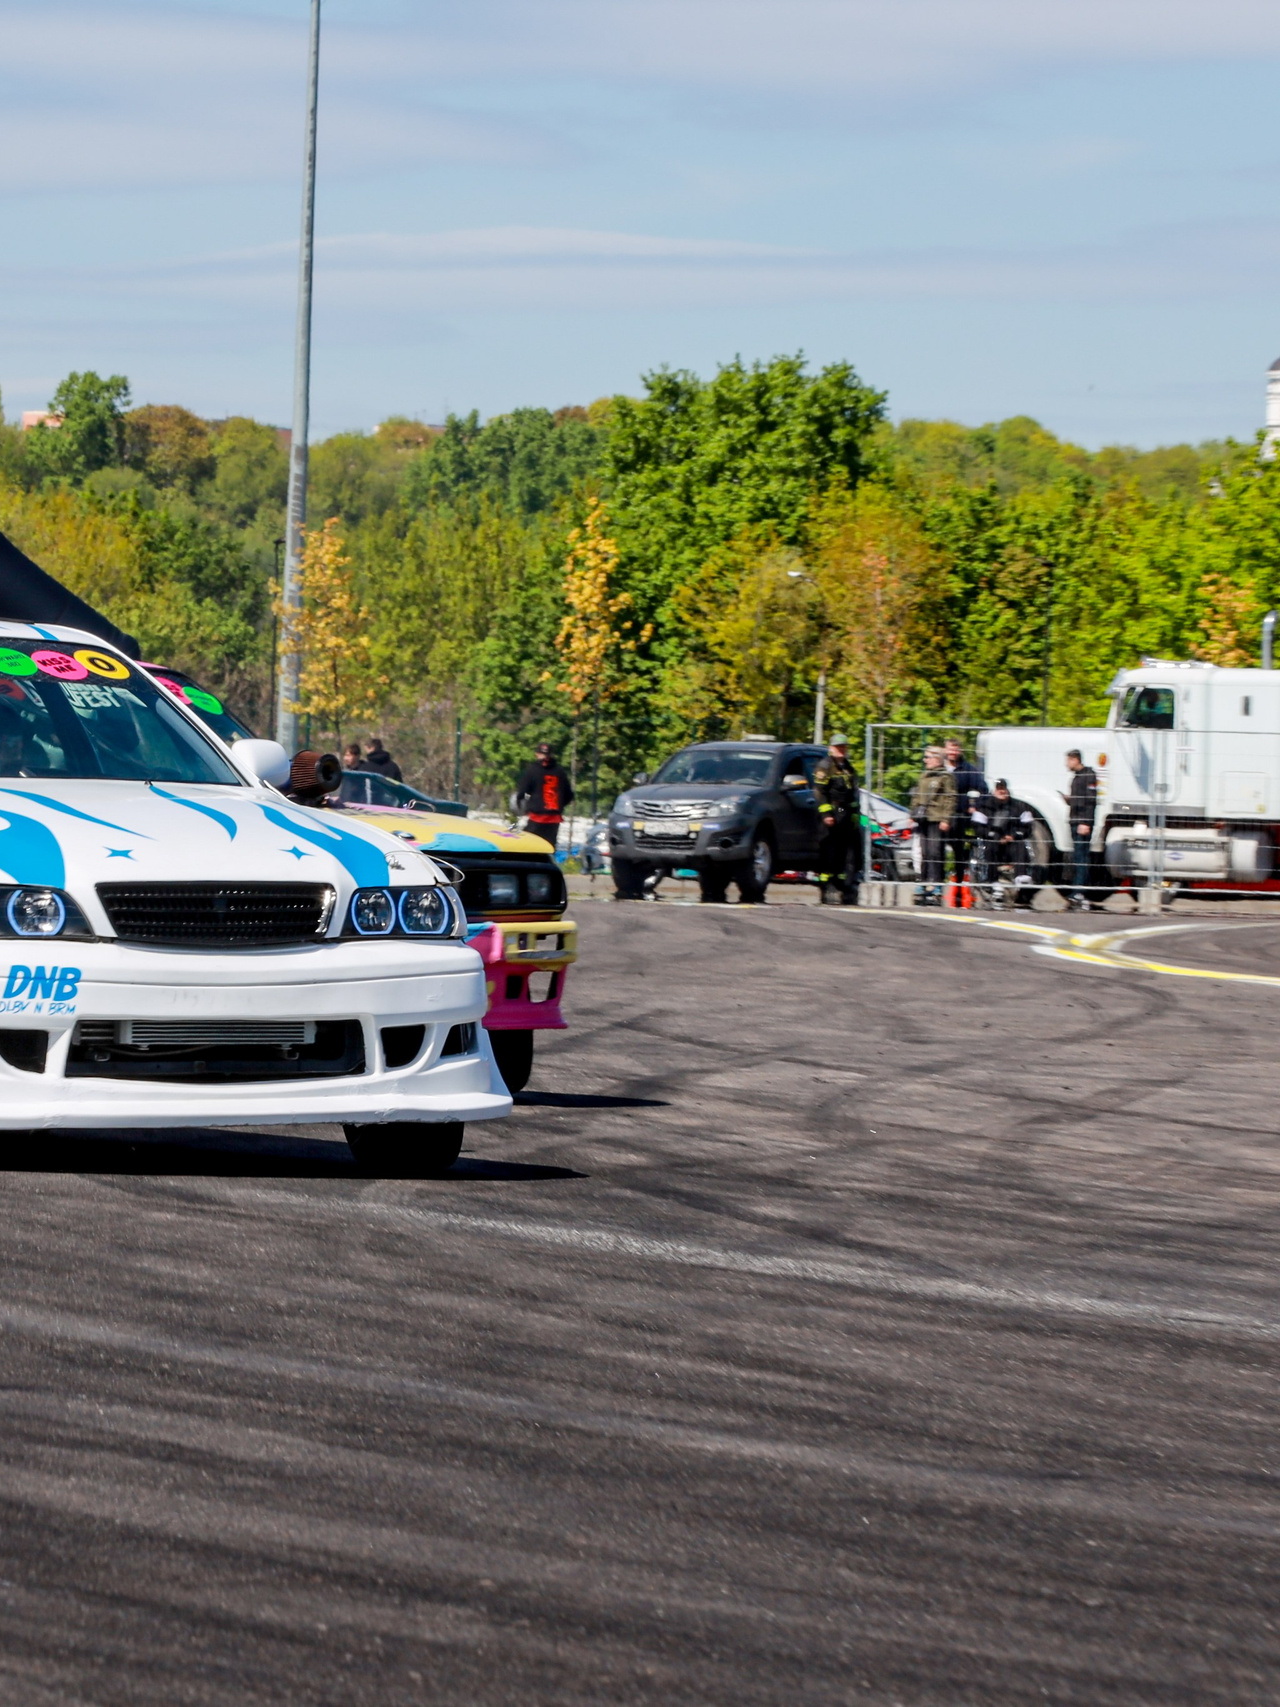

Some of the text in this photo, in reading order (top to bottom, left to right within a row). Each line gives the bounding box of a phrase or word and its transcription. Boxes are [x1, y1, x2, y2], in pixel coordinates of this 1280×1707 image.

[37, 656, 72, 667] KISS
[53, 664, 77, 674] ME
[2, 964, 82, 1002] DNB
